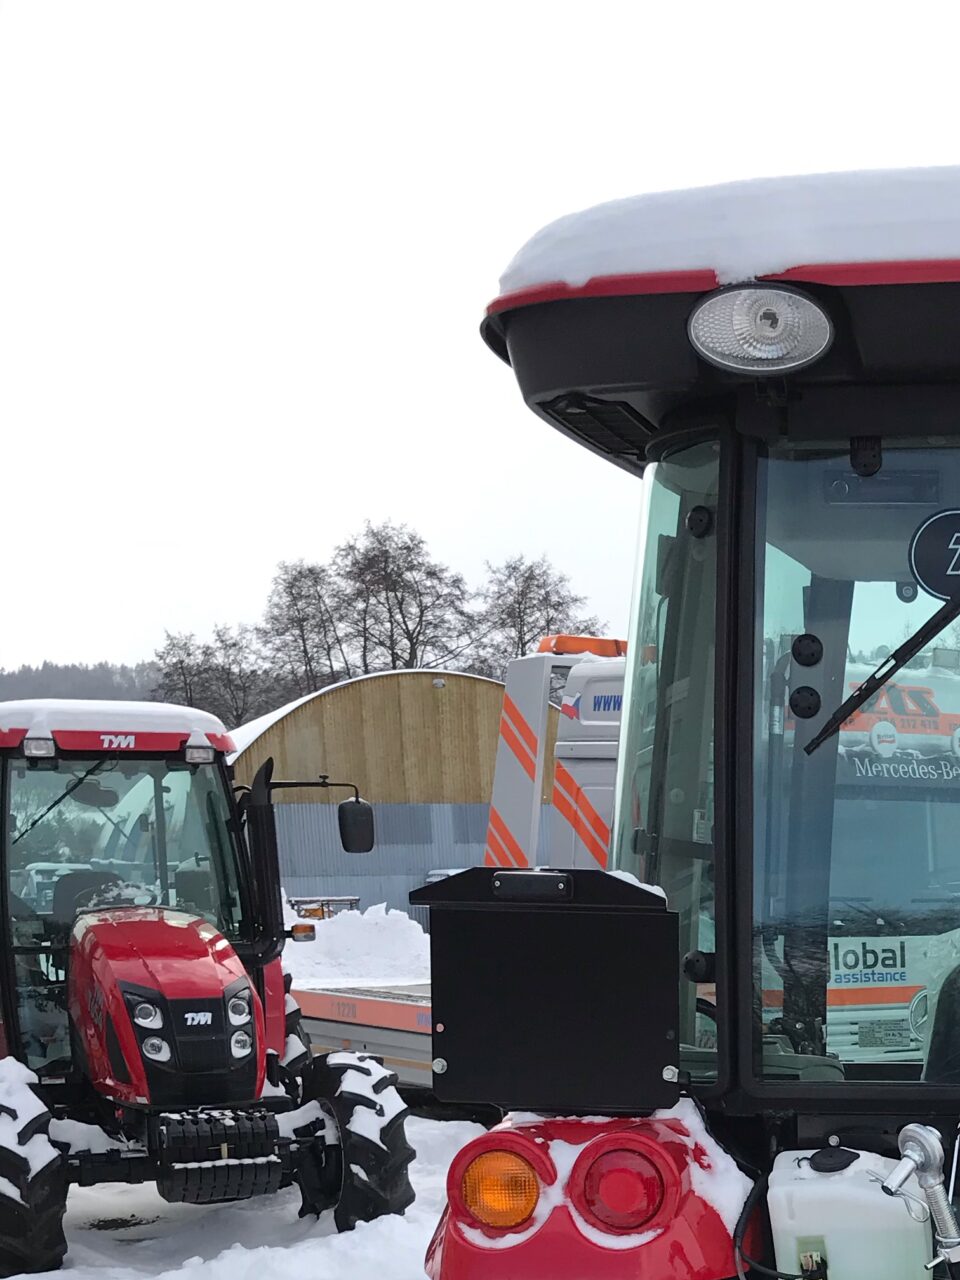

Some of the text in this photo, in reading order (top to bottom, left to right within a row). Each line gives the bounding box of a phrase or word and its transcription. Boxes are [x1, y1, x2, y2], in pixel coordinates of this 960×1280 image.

[100, 735, 135, 748] TYM
[829, 941, 906, 974] lobal
[834, 970, 907, 984] assistance
[184, 1012, 212, 1026] TYM
